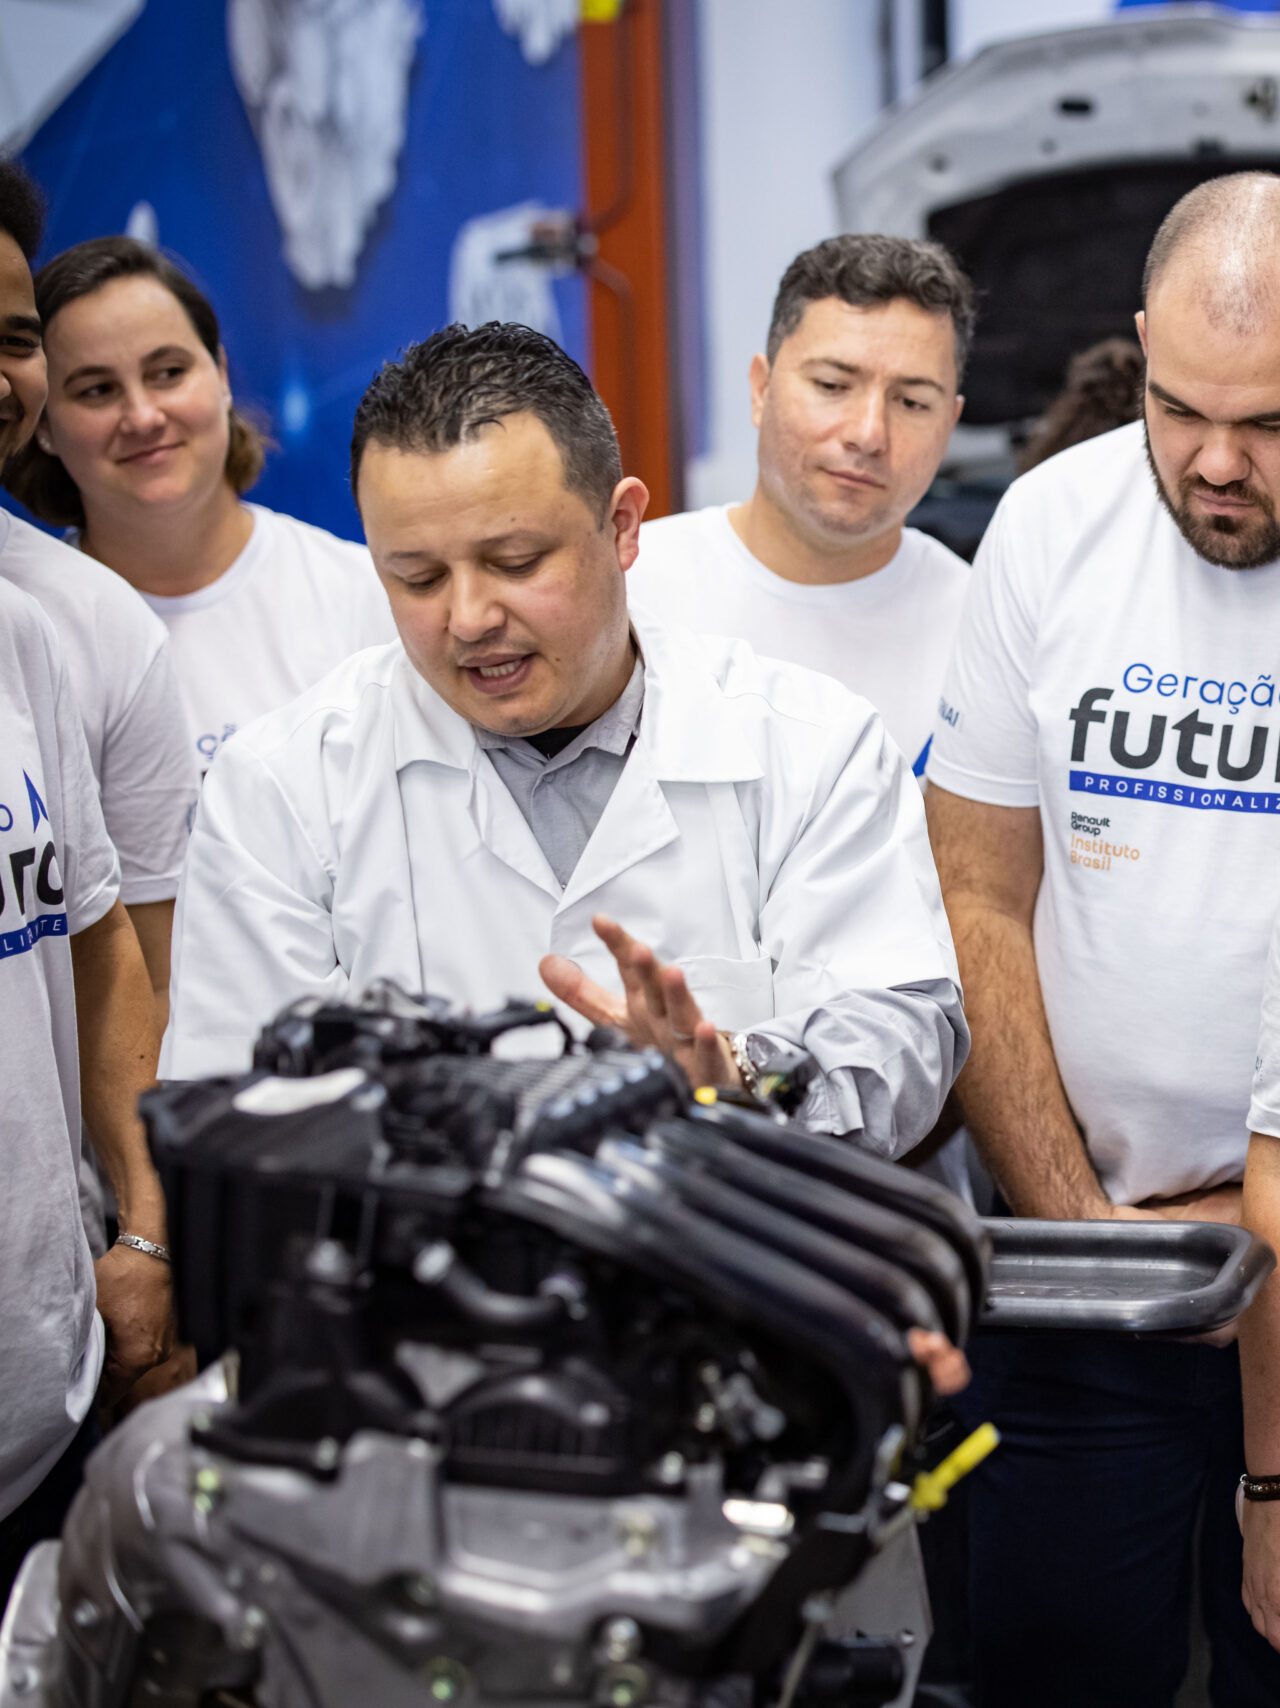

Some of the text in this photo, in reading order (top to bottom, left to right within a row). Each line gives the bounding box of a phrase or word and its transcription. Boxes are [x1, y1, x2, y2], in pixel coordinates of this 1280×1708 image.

[1071, 811, 1111, 828] Renault
[1071, 820, 1101, 837] Group
[1071, 833, 1140, 861] Instituto
[1070, 850, 1111, 872] Brasil
